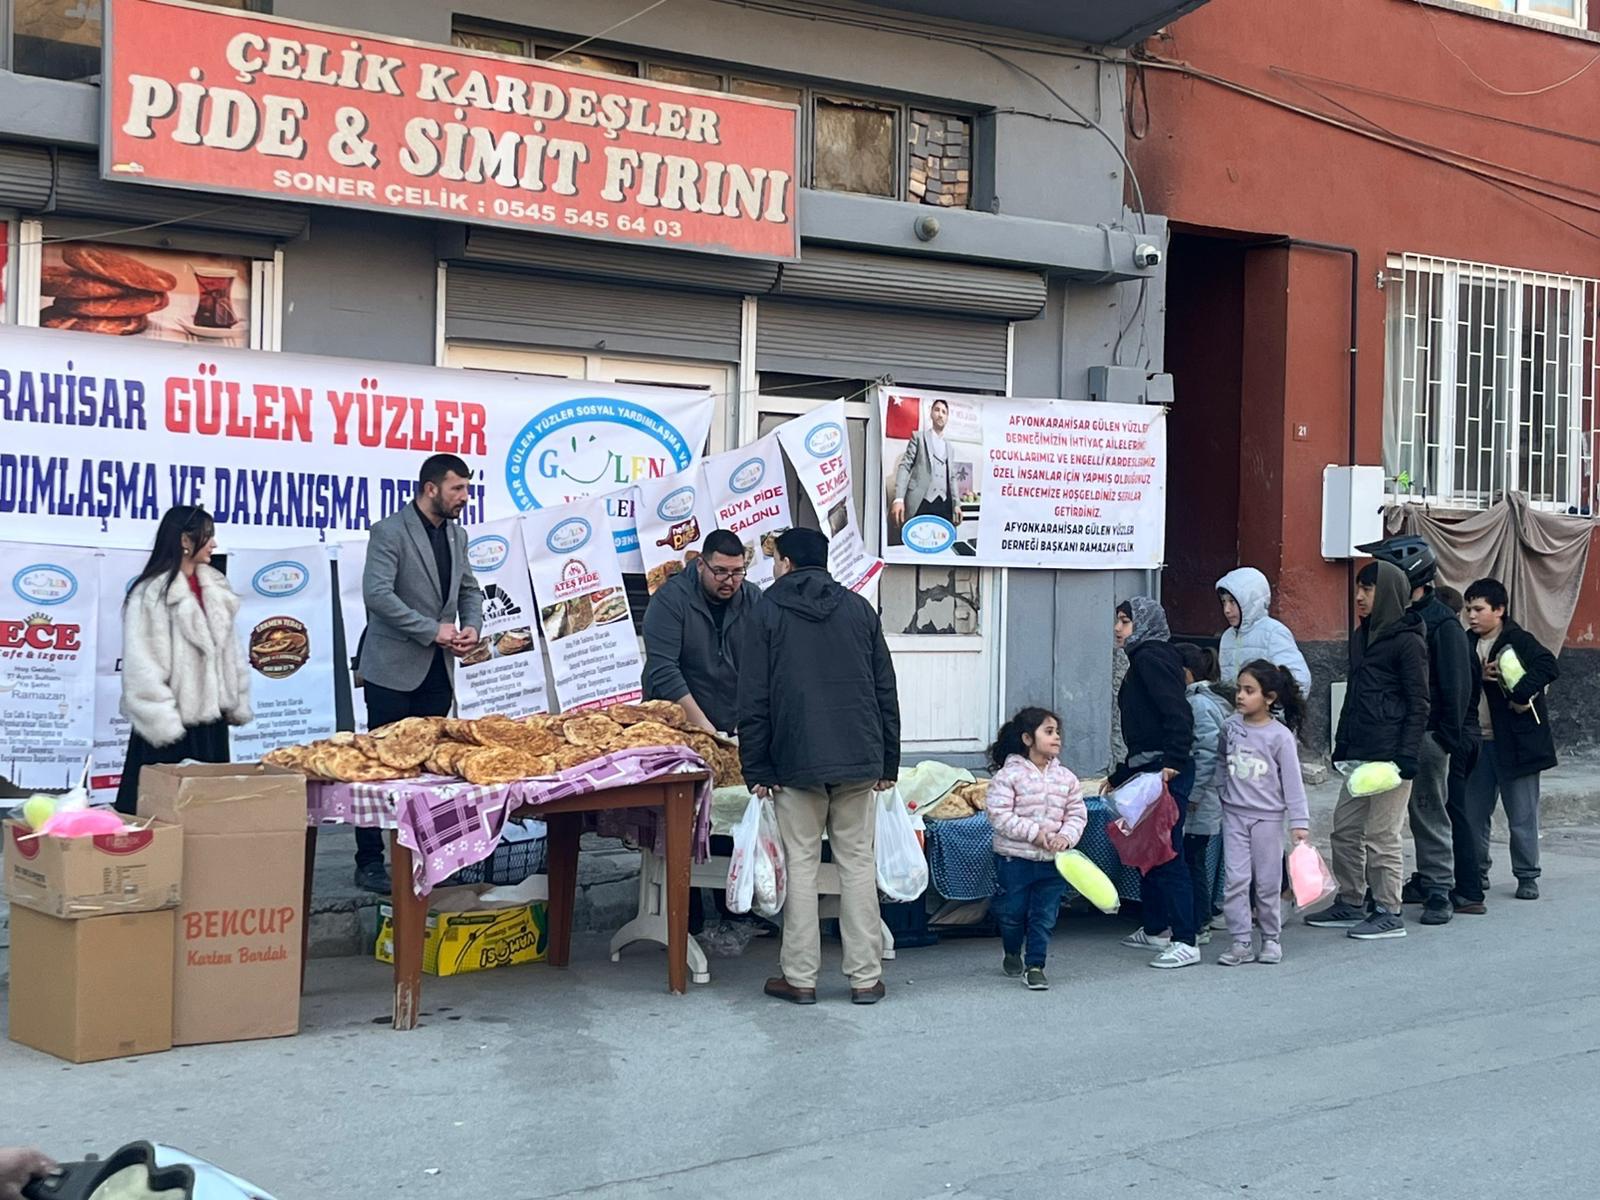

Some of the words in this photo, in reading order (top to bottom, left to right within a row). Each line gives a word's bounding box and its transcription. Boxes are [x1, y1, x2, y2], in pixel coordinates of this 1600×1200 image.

[226, 32, 402, 96] ÇELİK
[416, 63, 721, 145] KARDEŞLER
[122, 67, 304, 160] PİDE
[328, 106, 377, 169] &
[399, 107, 591, 196] SİMİT
[600, 146, 790, 223] FIRINI
[273, 170, 376, 199] SONER
[385, 184, 469, 211] ÇELİK
[493, 199, 556, 222] 0545
[564, 207, 609, 229] 545
[617, 215, 646, 232] 64
[653, 219, 682, 238] 03
[164, 363, 313, 442] GÜLEN
[327, 377, 487, 456] YÜZLER
[535, 408, 575, 435] YÜZLER
[575, 404, 615, 417] SOSYAL
[618, 407, 681, 452] YARDIMLAŞMA
[1009, 415, 1090, 430] AFYONKARAHİSAR
[1092, 418, 1120, 432] GÜLEN
[1297, 425, 1307, 437] 21
[1006, 432, 1067, 446] DERNEĞİMİZİN
[989, 449, 1055, 463] ÇOCUKLARIMIZ
[1057, 453, 1068, 464] VE
[1070, 453, 1104, 466] ENGELLİ
[993, 465, 1015, 478] ÖZEL
[1017, 466, 1062, 481] İNSANLAR
[1063, 468, 1080, 484] İÇİN
[1082, 472, 1112, 486] YAPMIŞ
[169, 464, 207, 511] VE
[214, 468, 371, 542] DAYANIŞMA
[719, 500, 752, 521] RÜYA
[753, 485, 784, 505] PİDE
[1001, 483, 1061, 498] EĞLENCEMİZE
[1063, 488, 1116, 502] HOŞGELDİNİZ
[729, 504, 781, 534] SALONU
[1004, 520, 1083, 535] AFYONKARAHİSAR
[1085, 522, 1110, 536] GÜLEN
[1001, 538, 1039, 552] DERNEĞİ
[1040, 540, 1078, 555] BAŞKANI
[1080, 541, 1116, 553] RAMAZAN
[1116, 539, 1135, 555] ÇELİK
[554, 578, 577, 592] ATEŞ
[0, 620, 81, 651] ECE
[0, 649, 23, 660] afe
[11, 689, 67, 702] Ramazan
[182, 906, 295, 940] BENCUP
[187, 949, 233, 967] Karton
[237, 943, 289, 965] Bardak
